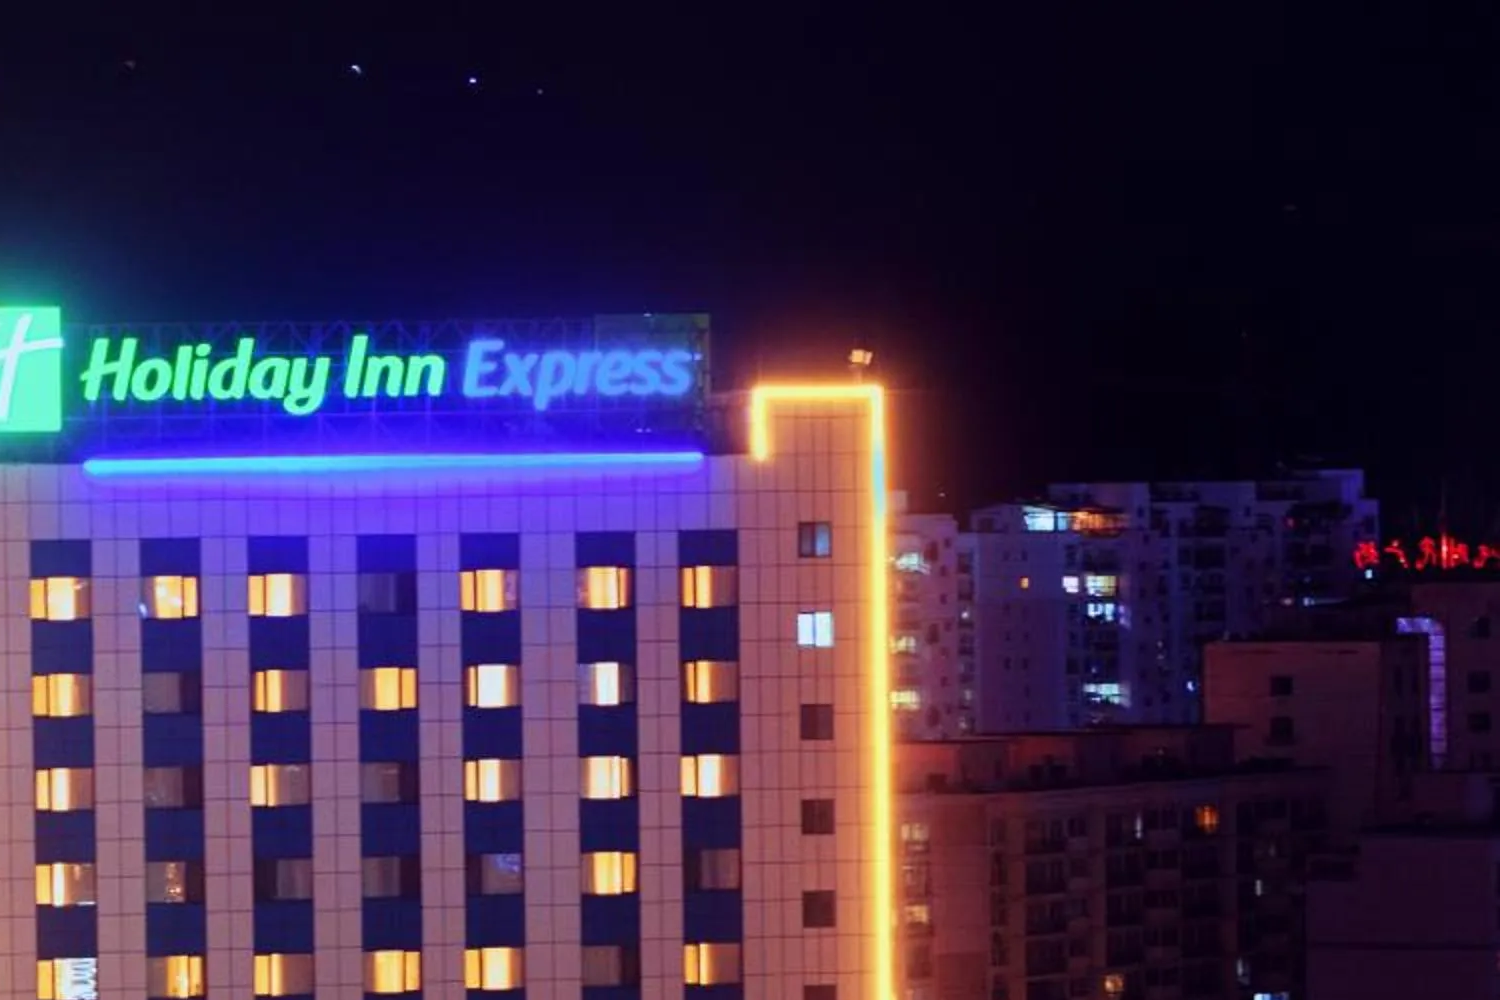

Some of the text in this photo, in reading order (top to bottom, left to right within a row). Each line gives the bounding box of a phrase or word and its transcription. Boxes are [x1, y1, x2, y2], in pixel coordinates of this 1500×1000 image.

[79, 334, 691, 416] Holiday Inn Express
